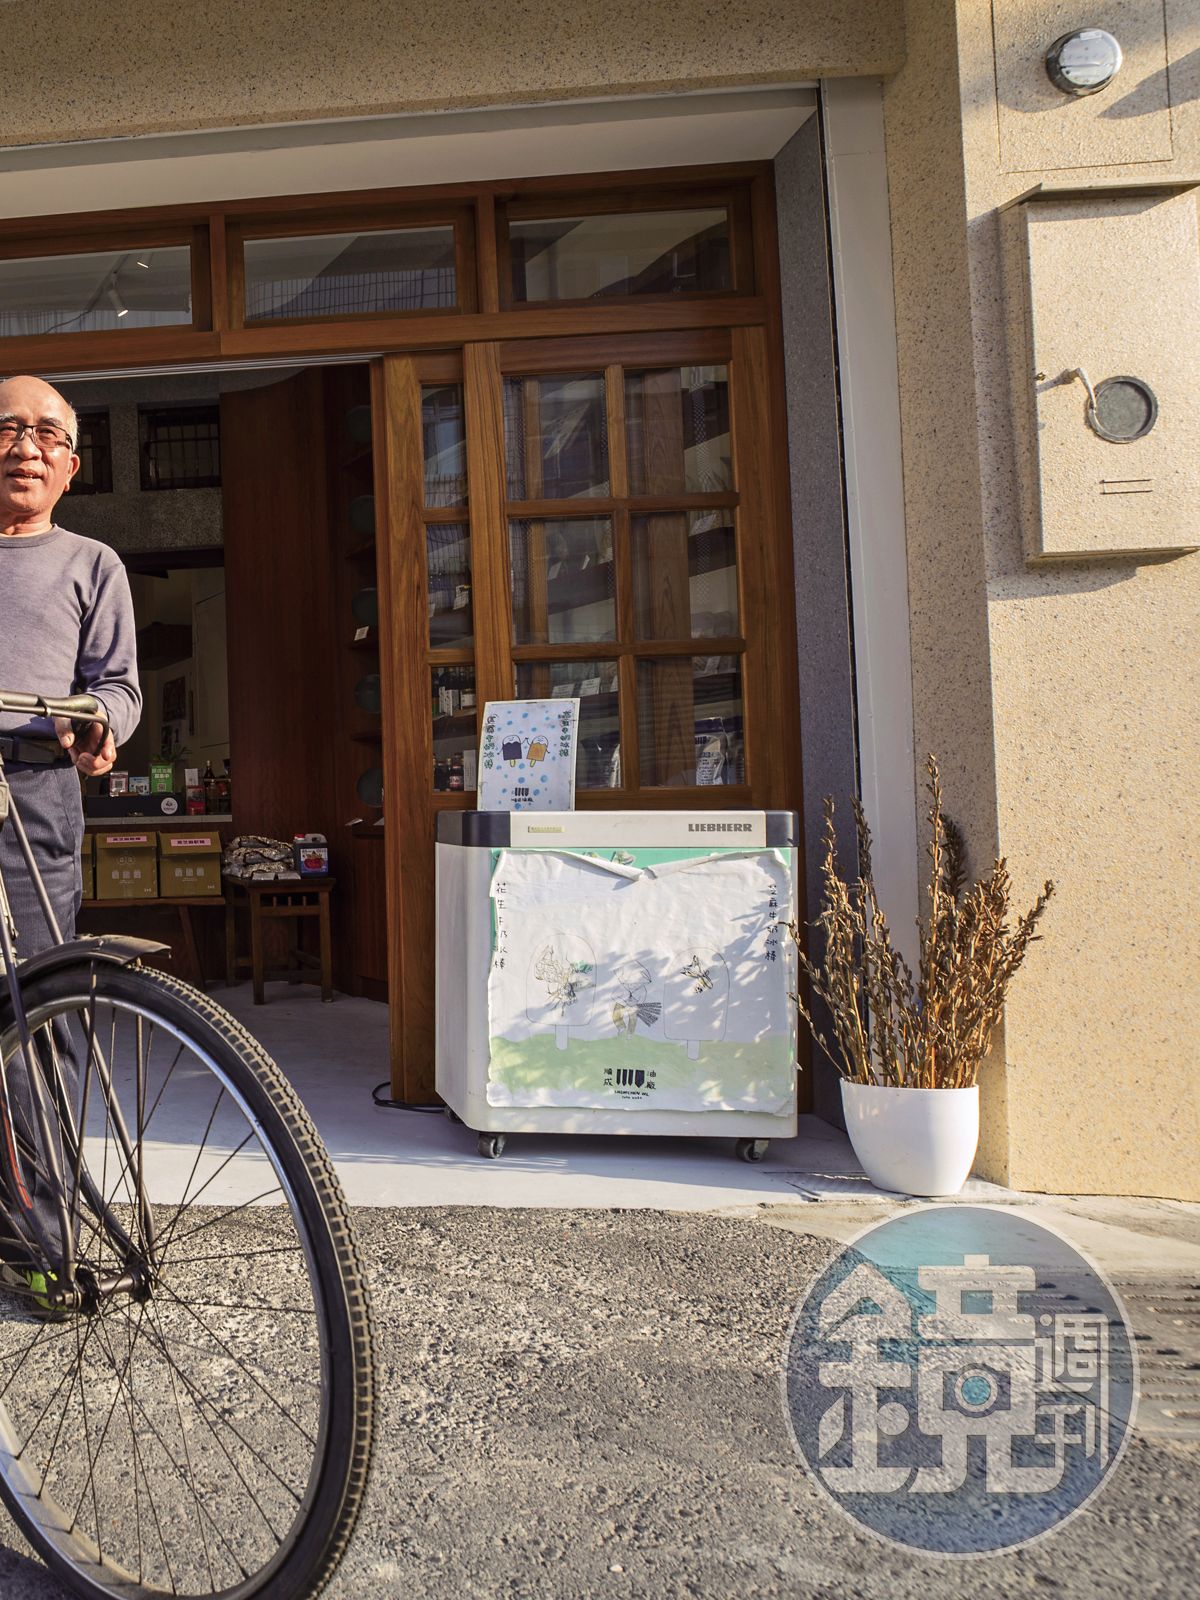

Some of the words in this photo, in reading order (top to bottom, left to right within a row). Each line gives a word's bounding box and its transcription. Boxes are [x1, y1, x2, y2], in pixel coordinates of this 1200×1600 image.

[688, 823, 752, 832] LIEBHERR
[764, 883, 778, 962] 芝麻牛奶冰棒
